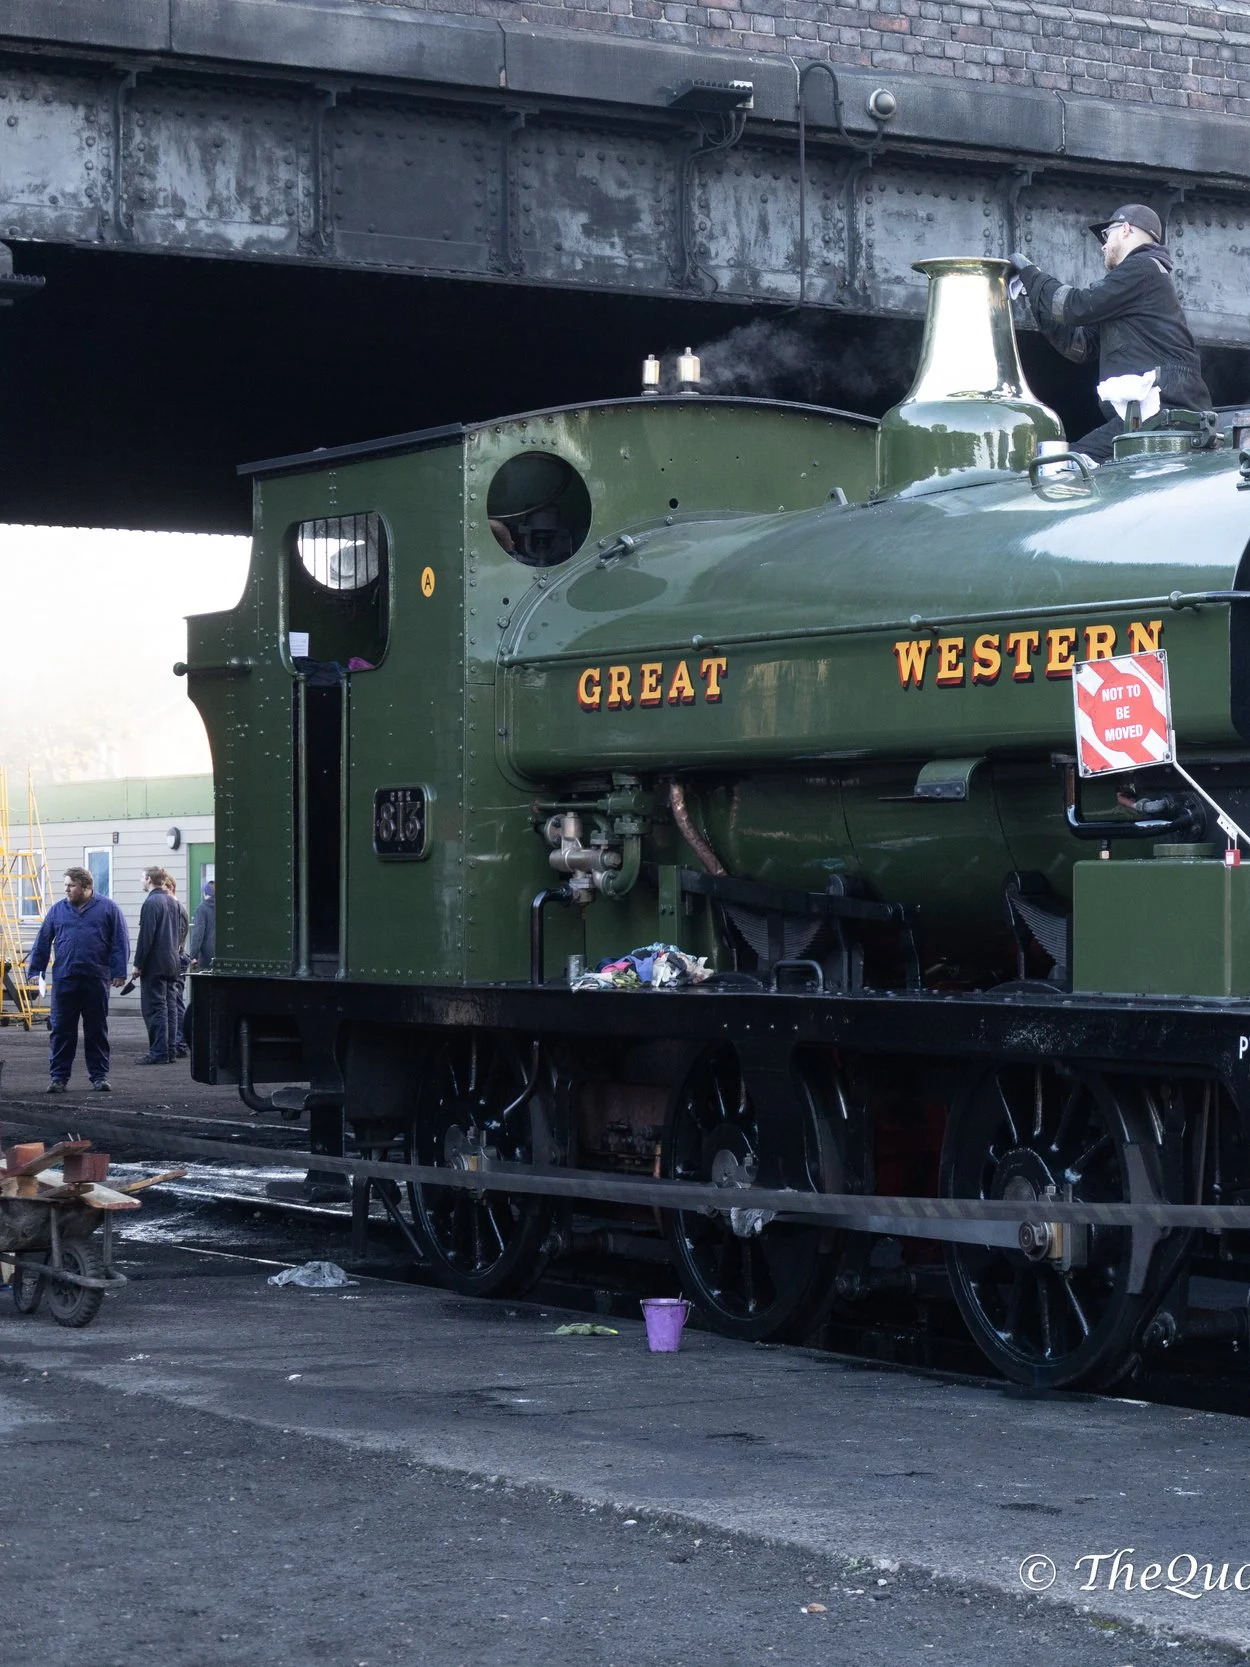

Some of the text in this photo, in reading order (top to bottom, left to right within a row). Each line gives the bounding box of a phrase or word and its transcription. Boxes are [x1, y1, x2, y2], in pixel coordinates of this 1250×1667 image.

[577, 656, 728, 711] GREAT
[893, 621, 1164, 687] WESTERN
[1102, 684, 1141, 702] NOT TO
[1116, 706, 1131, 720] BE
[1105, 725, 1143, 742] MOVED
[379, 801, 421, 841] 813
